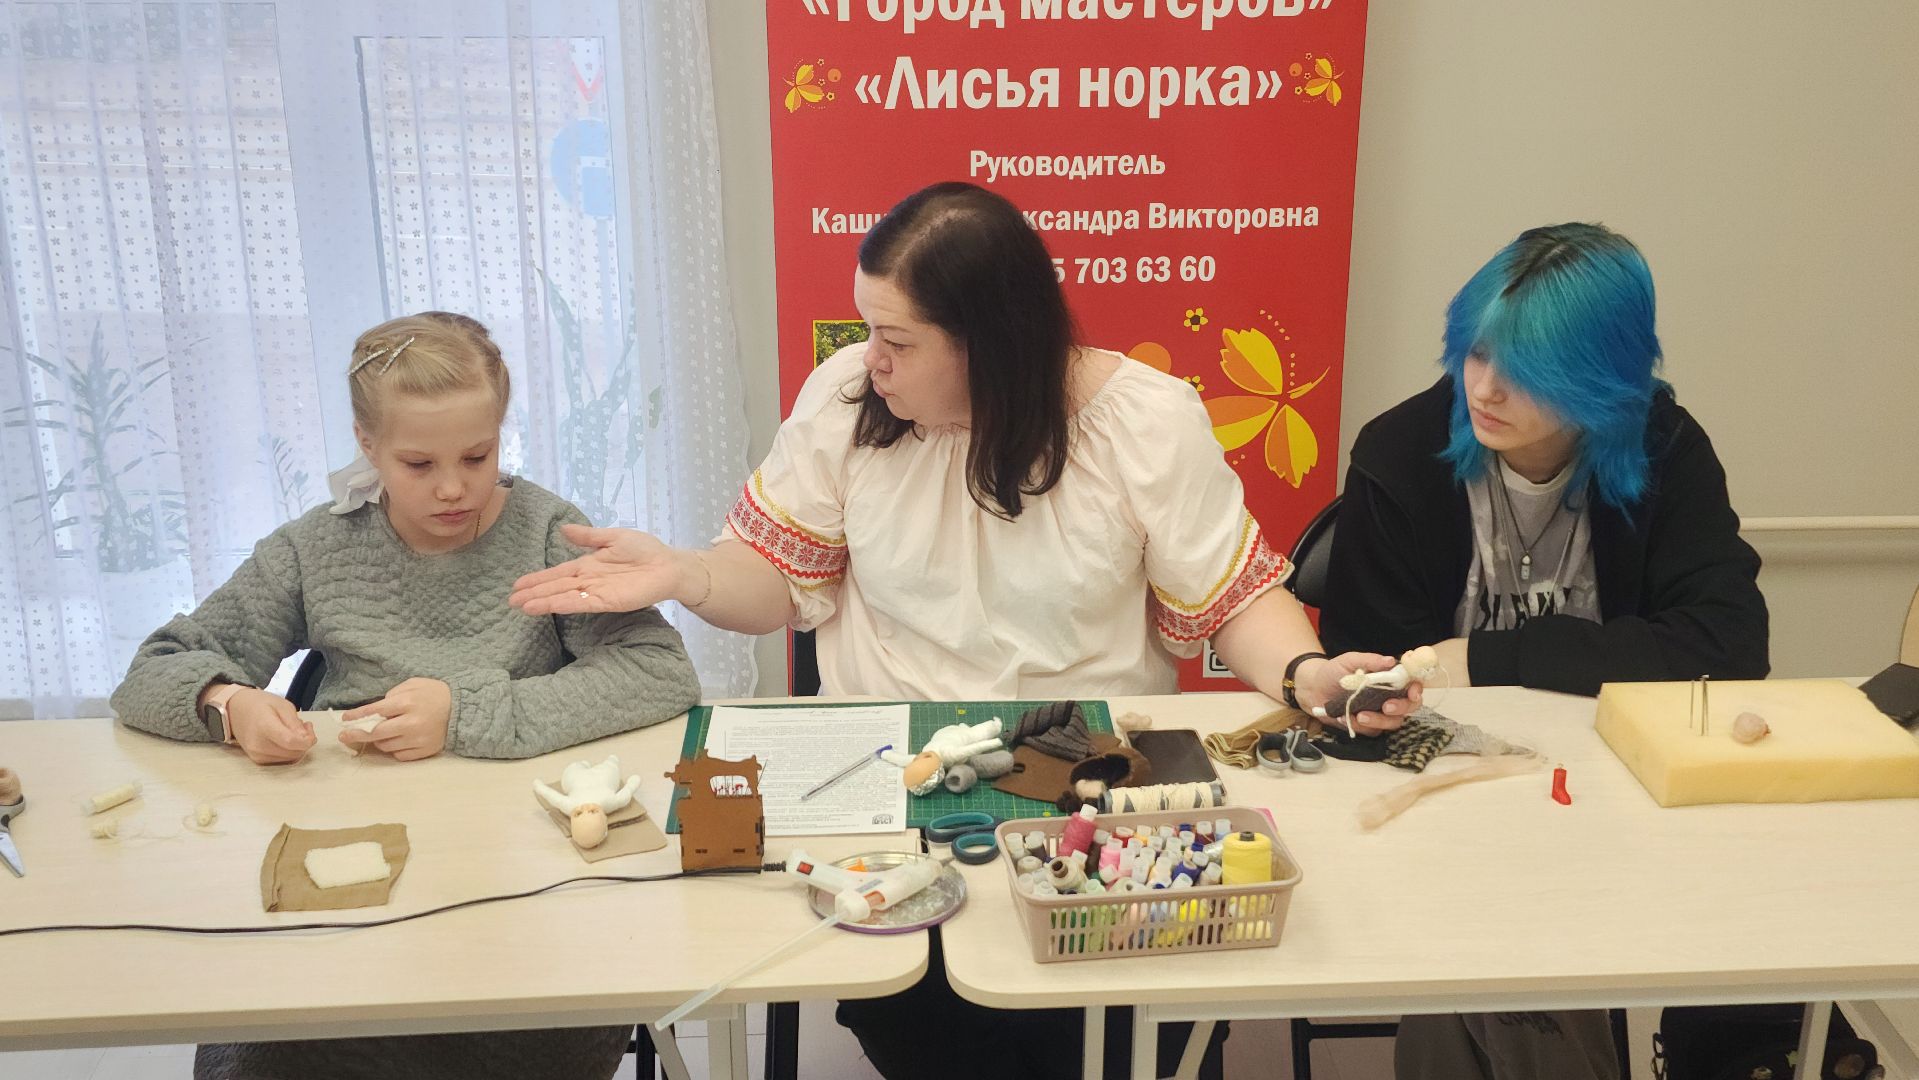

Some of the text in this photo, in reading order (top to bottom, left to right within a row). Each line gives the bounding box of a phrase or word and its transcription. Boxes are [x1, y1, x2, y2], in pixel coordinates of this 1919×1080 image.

[854, 56, 1283, 119] «Лисья норка»
[970, 150, 1166, 183] Руководитель
[1021, 209, 1140, 236] ксандра
[1148, 202, 1319, 235] Викторовна
[1074, 257, 1127, 284] 703
[1136, 255, 1171, 283] 63
[1179, 255, 1216, 282] 60
